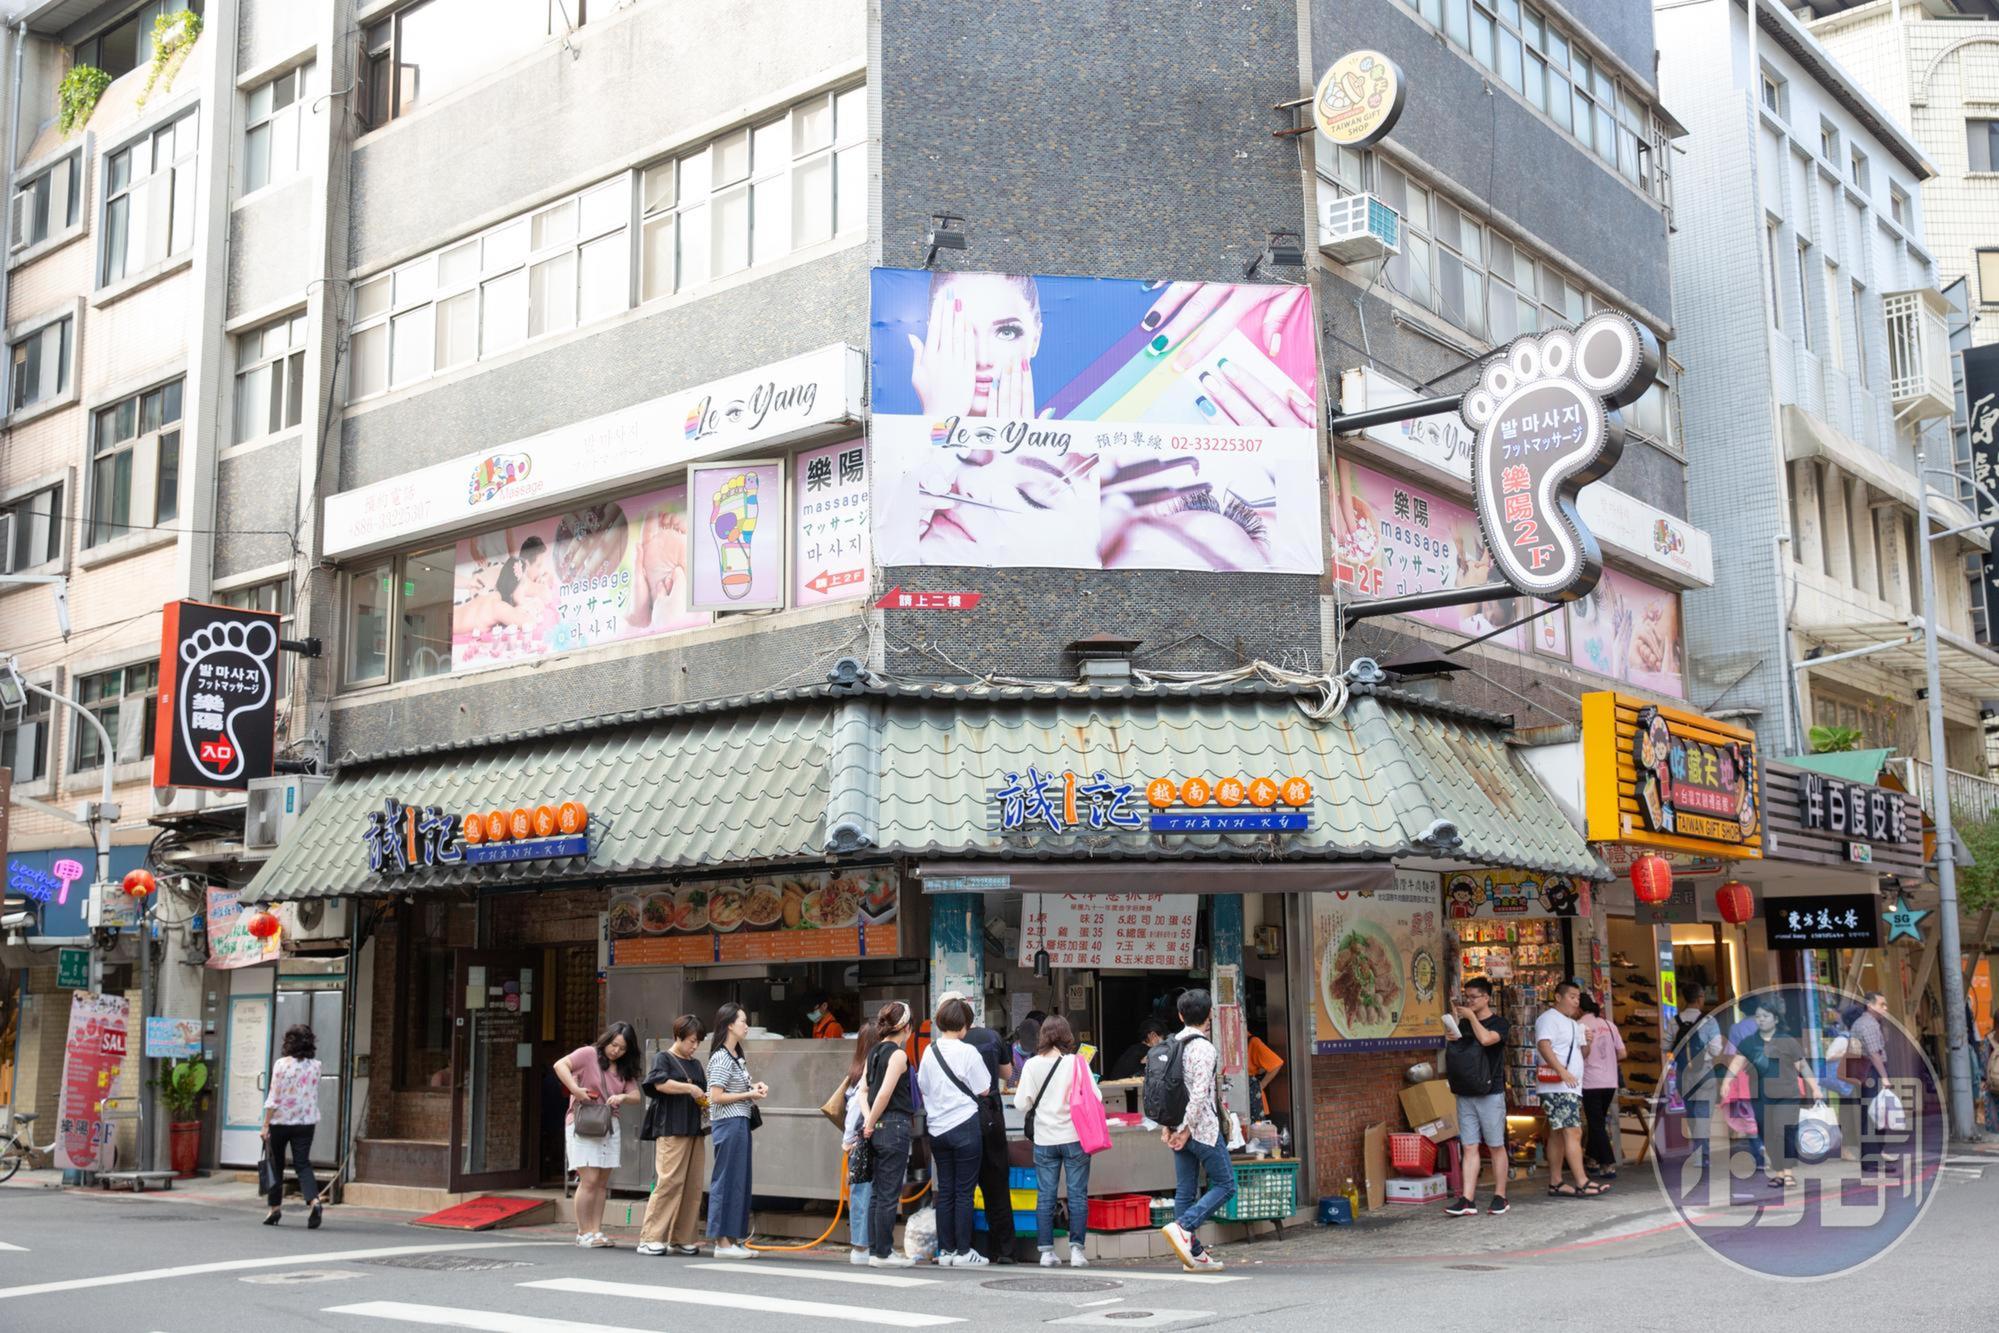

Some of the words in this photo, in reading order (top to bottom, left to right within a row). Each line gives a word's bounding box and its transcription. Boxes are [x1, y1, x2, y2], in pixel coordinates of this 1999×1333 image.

[1331, 118, 1362, 133] TAIWAN
[1363, 109, 1382, 121] GIFT
[1348, 122, 1369, 136] SHOP
[693, 395, 720, 440] Le
[747, 381, 818, 430] Yang
[1501, 404, 1581, 440] 발마사지
[942, 415, 970, 449] Le
[1000, 421, 1072, 456] Yang
[1171, 435, 1263, 453] 02-33225307
[1502, 425, 1584, 460] フットマッサージ
[807, 449, 864, 493] 樂陽
[499, 479, 544, 501] Massage
[803, 491, 868, 516] massage
[1394, 489, 1429, 529] 樂陽
[803, 509, 868, 537] マッサージ
[807, 534, 862, 563] 마사지
[1381, 519, 1449, 559] massage
[1384, 547, 1449, 586] マッサージ
[559, 570, 629, 597] massage
[1358, 564, 1384, 595] 2F
[558, 591, 627, 619] マッサージ
[899, 594, 961, 607] 請上二樓
[570, 615, 617, 640] 마사지
[199, 663, 259, 683] 발마사지
[197, 678, 260, 695] フットマッサージ
[191, 692, 225, 732] 樂陽
[202, 744, 232, 759] 入口
[1150, 780, 1310, 805] 越南麵食館
[465, 805, 579, 841] 越南麵食館
[1677, 815, 1705, 835] TAIWAN
[1706, 820, 1720, 837] GIFT
[1721, 823, 1740, 840] SHOP
[10, 860, 63, 889] Leather
[10, 876, 54, 901] Crafts
[1094, 913, 1104, 924] 25
[1182, 915, 1192, 926] 45
[1894, 914, 1911, 924] SG
[1092, 927, 1103, 938] 35
[1181, 929, 1191, 939] 55
[1091, 941, 1102, 951] 40
[1180, 942, 1190, 952] 45
[1090, 954, 1101, 964] 45
[1179, 955, 1189, 966] 55
[102, 1032, 126, 1051] SAL
